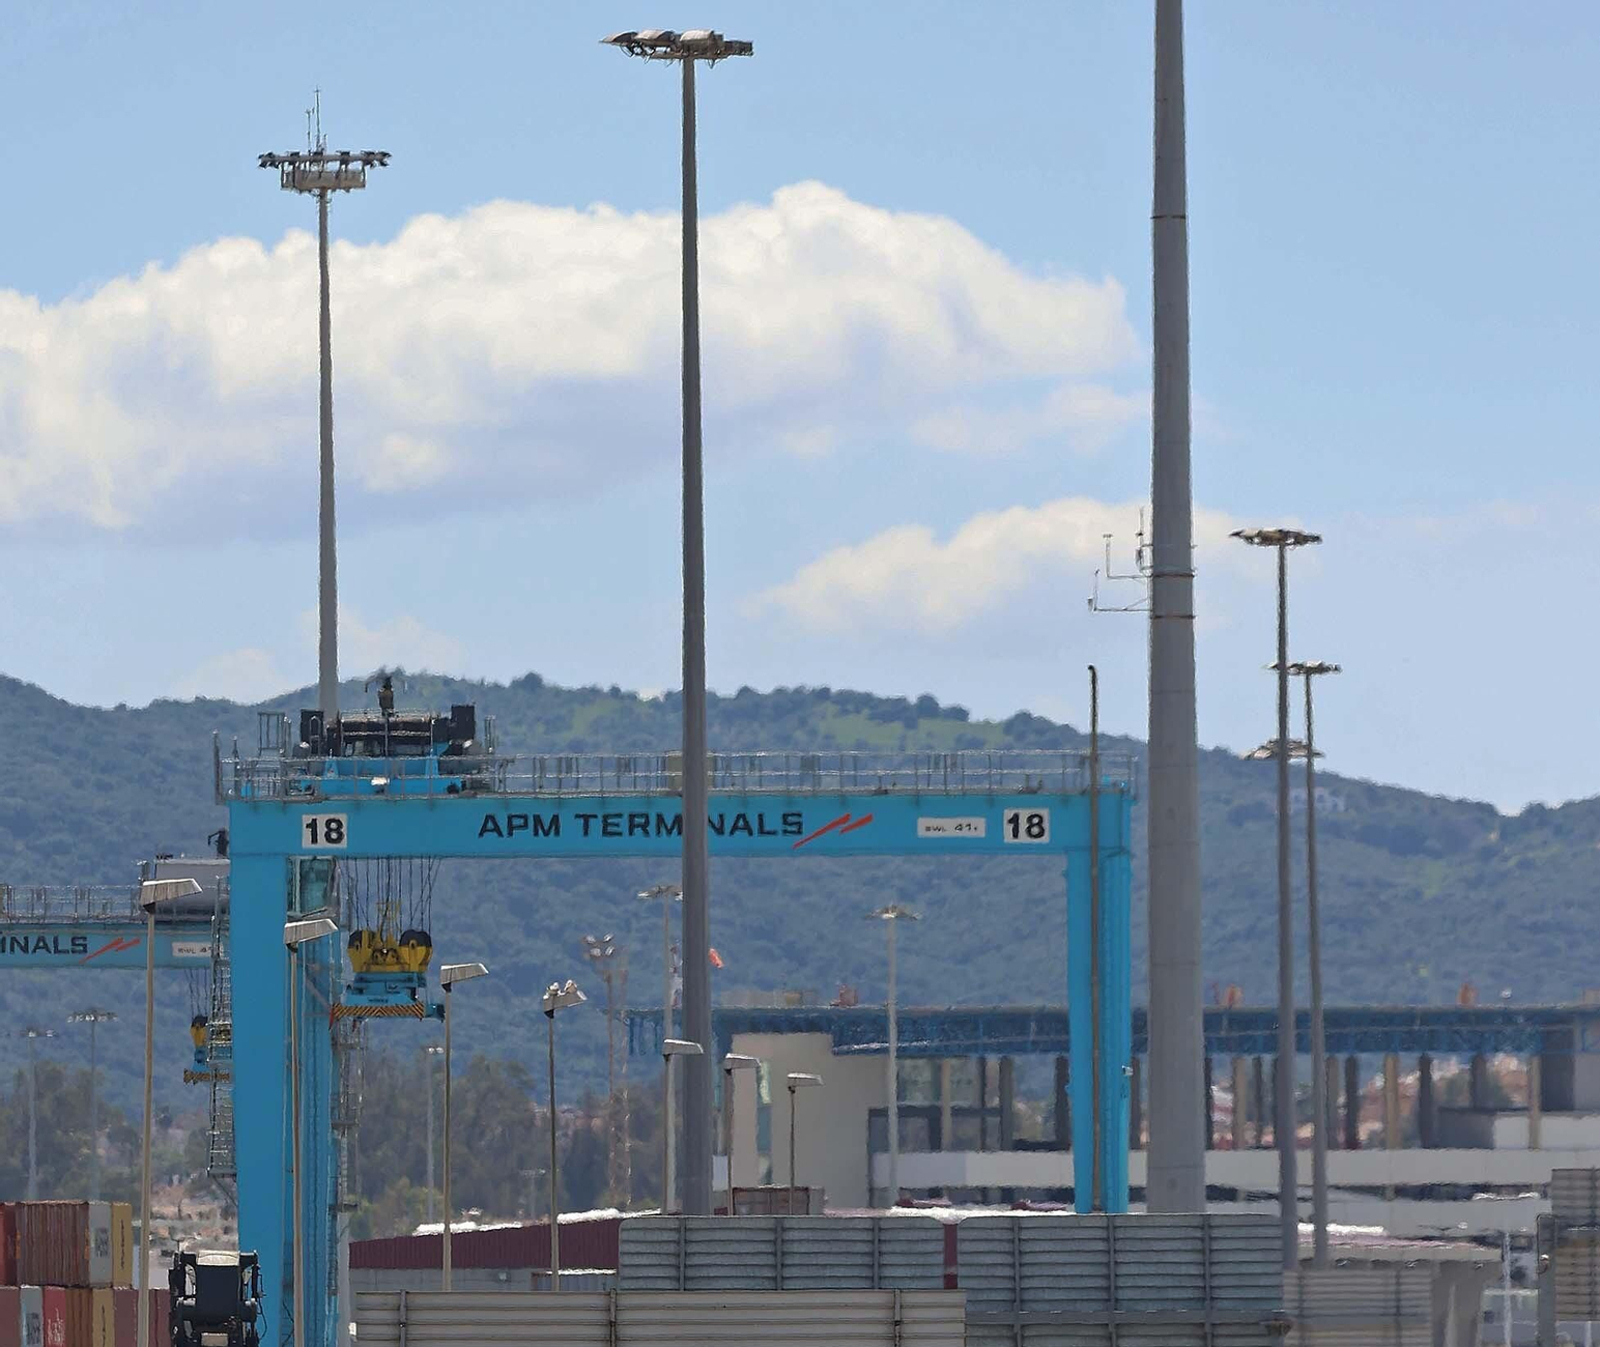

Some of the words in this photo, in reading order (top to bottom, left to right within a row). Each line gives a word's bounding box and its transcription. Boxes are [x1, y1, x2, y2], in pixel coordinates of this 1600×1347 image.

[305, 817, 345, 845] 18
[477, 813, 561, 839] APM
[574, 812, 804, 838] TERMNALS
[1007, 812, 1046, 840] 18
